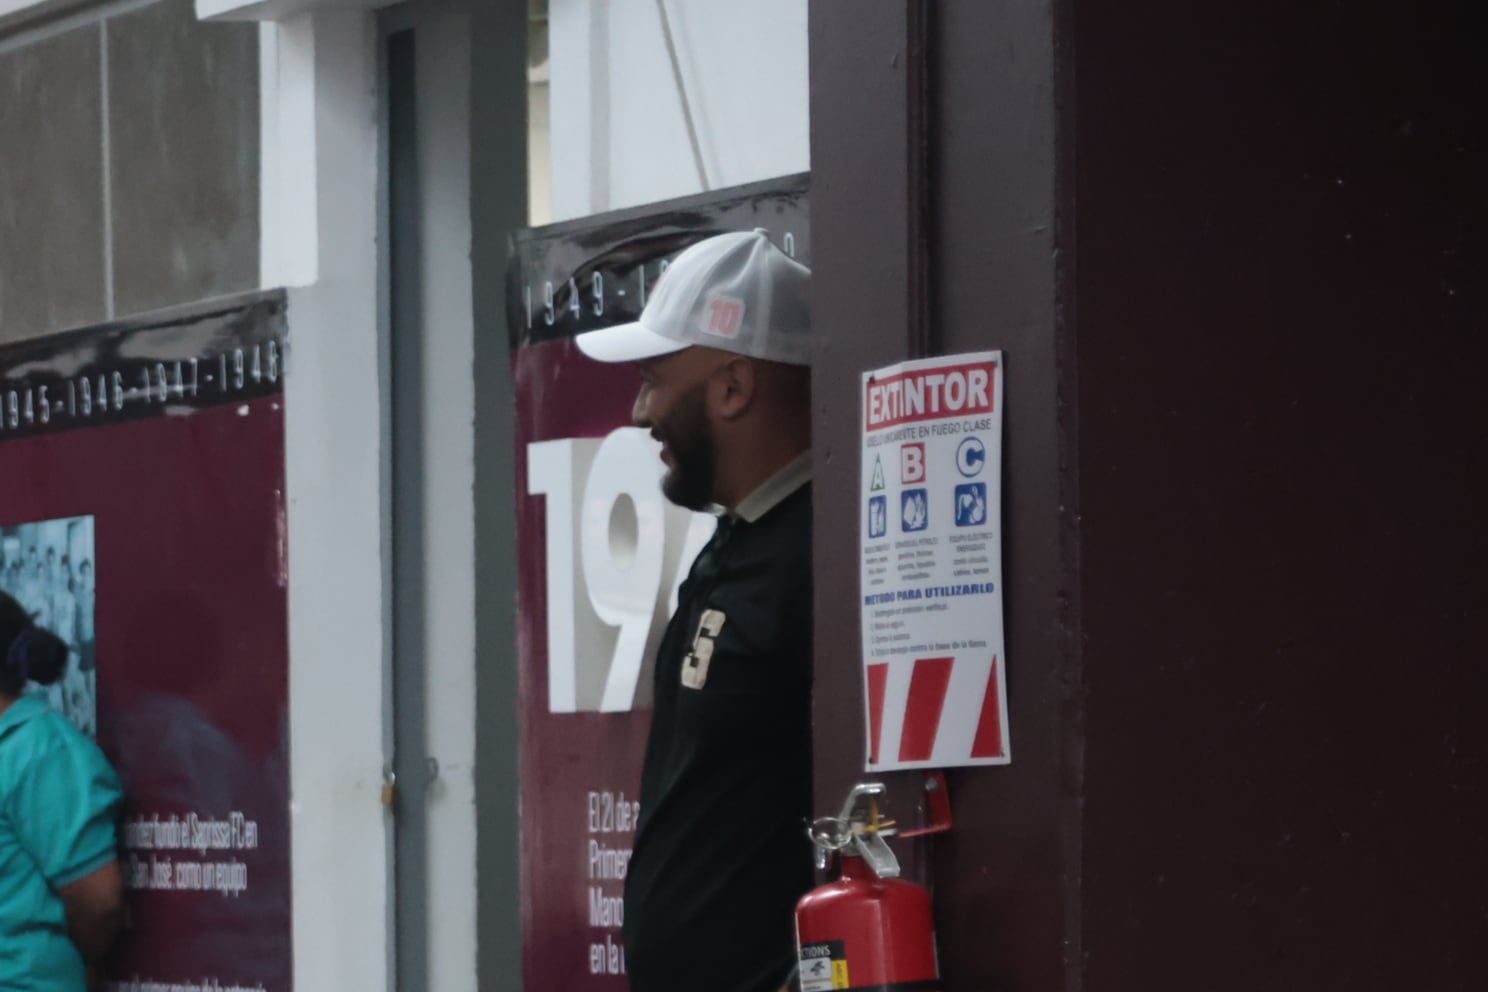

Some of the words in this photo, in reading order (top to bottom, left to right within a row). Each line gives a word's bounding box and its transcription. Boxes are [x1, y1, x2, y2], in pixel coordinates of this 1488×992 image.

[869, 368, 990, 426] EXTINTOR
[918, 426, 930, 439] EN
[931, 422, 961, 437] FUEGO
[962, 418, 992, 433] CLASE
[900, 445, 924, 483] B
[956, 436, 985, 478] C
[897, 588, 922, 601] PARA
[924, 582, 994, 599] UTILIZARLO
